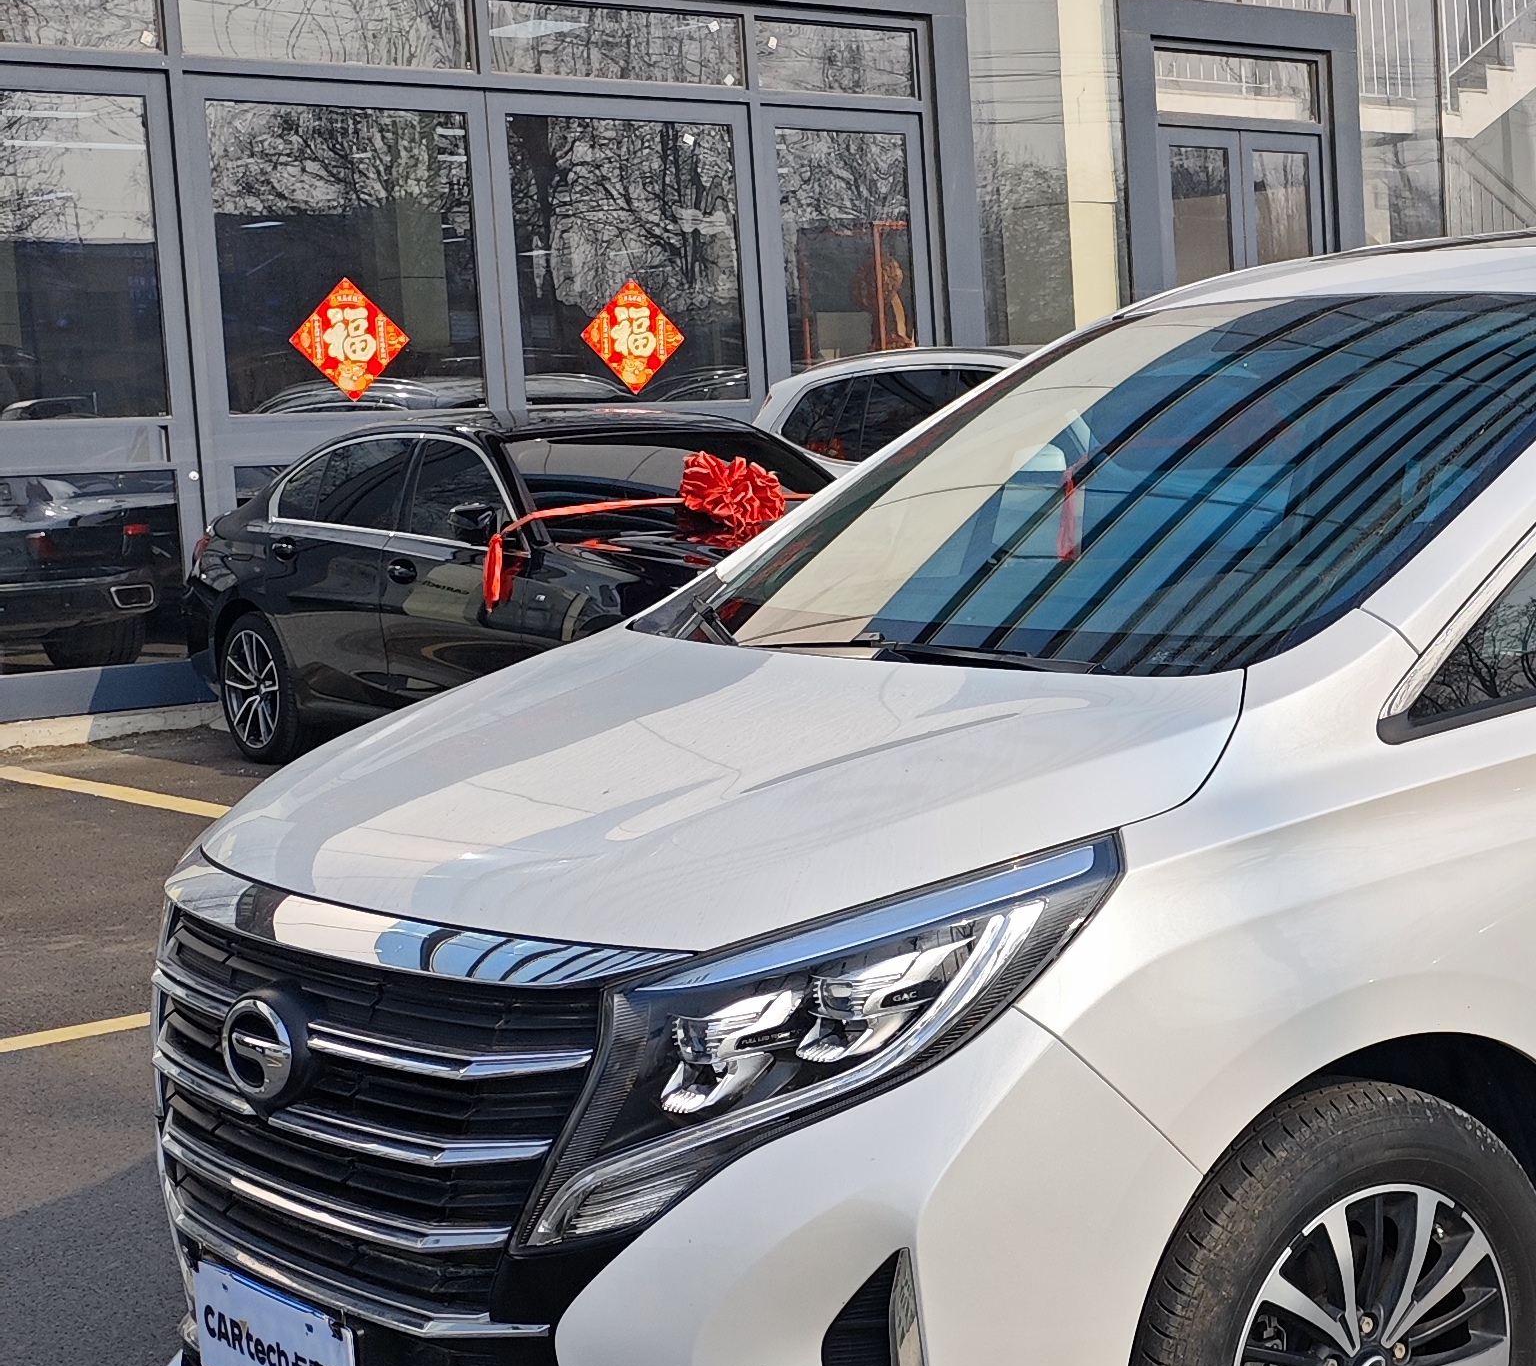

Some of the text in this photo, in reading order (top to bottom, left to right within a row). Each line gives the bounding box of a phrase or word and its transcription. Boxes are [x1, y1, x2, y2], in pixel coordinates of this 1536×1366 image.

[323, 307, 377, 362] 福
[611, 306, 657, 358] 福
[892, 990, 918, 1002] GAC
